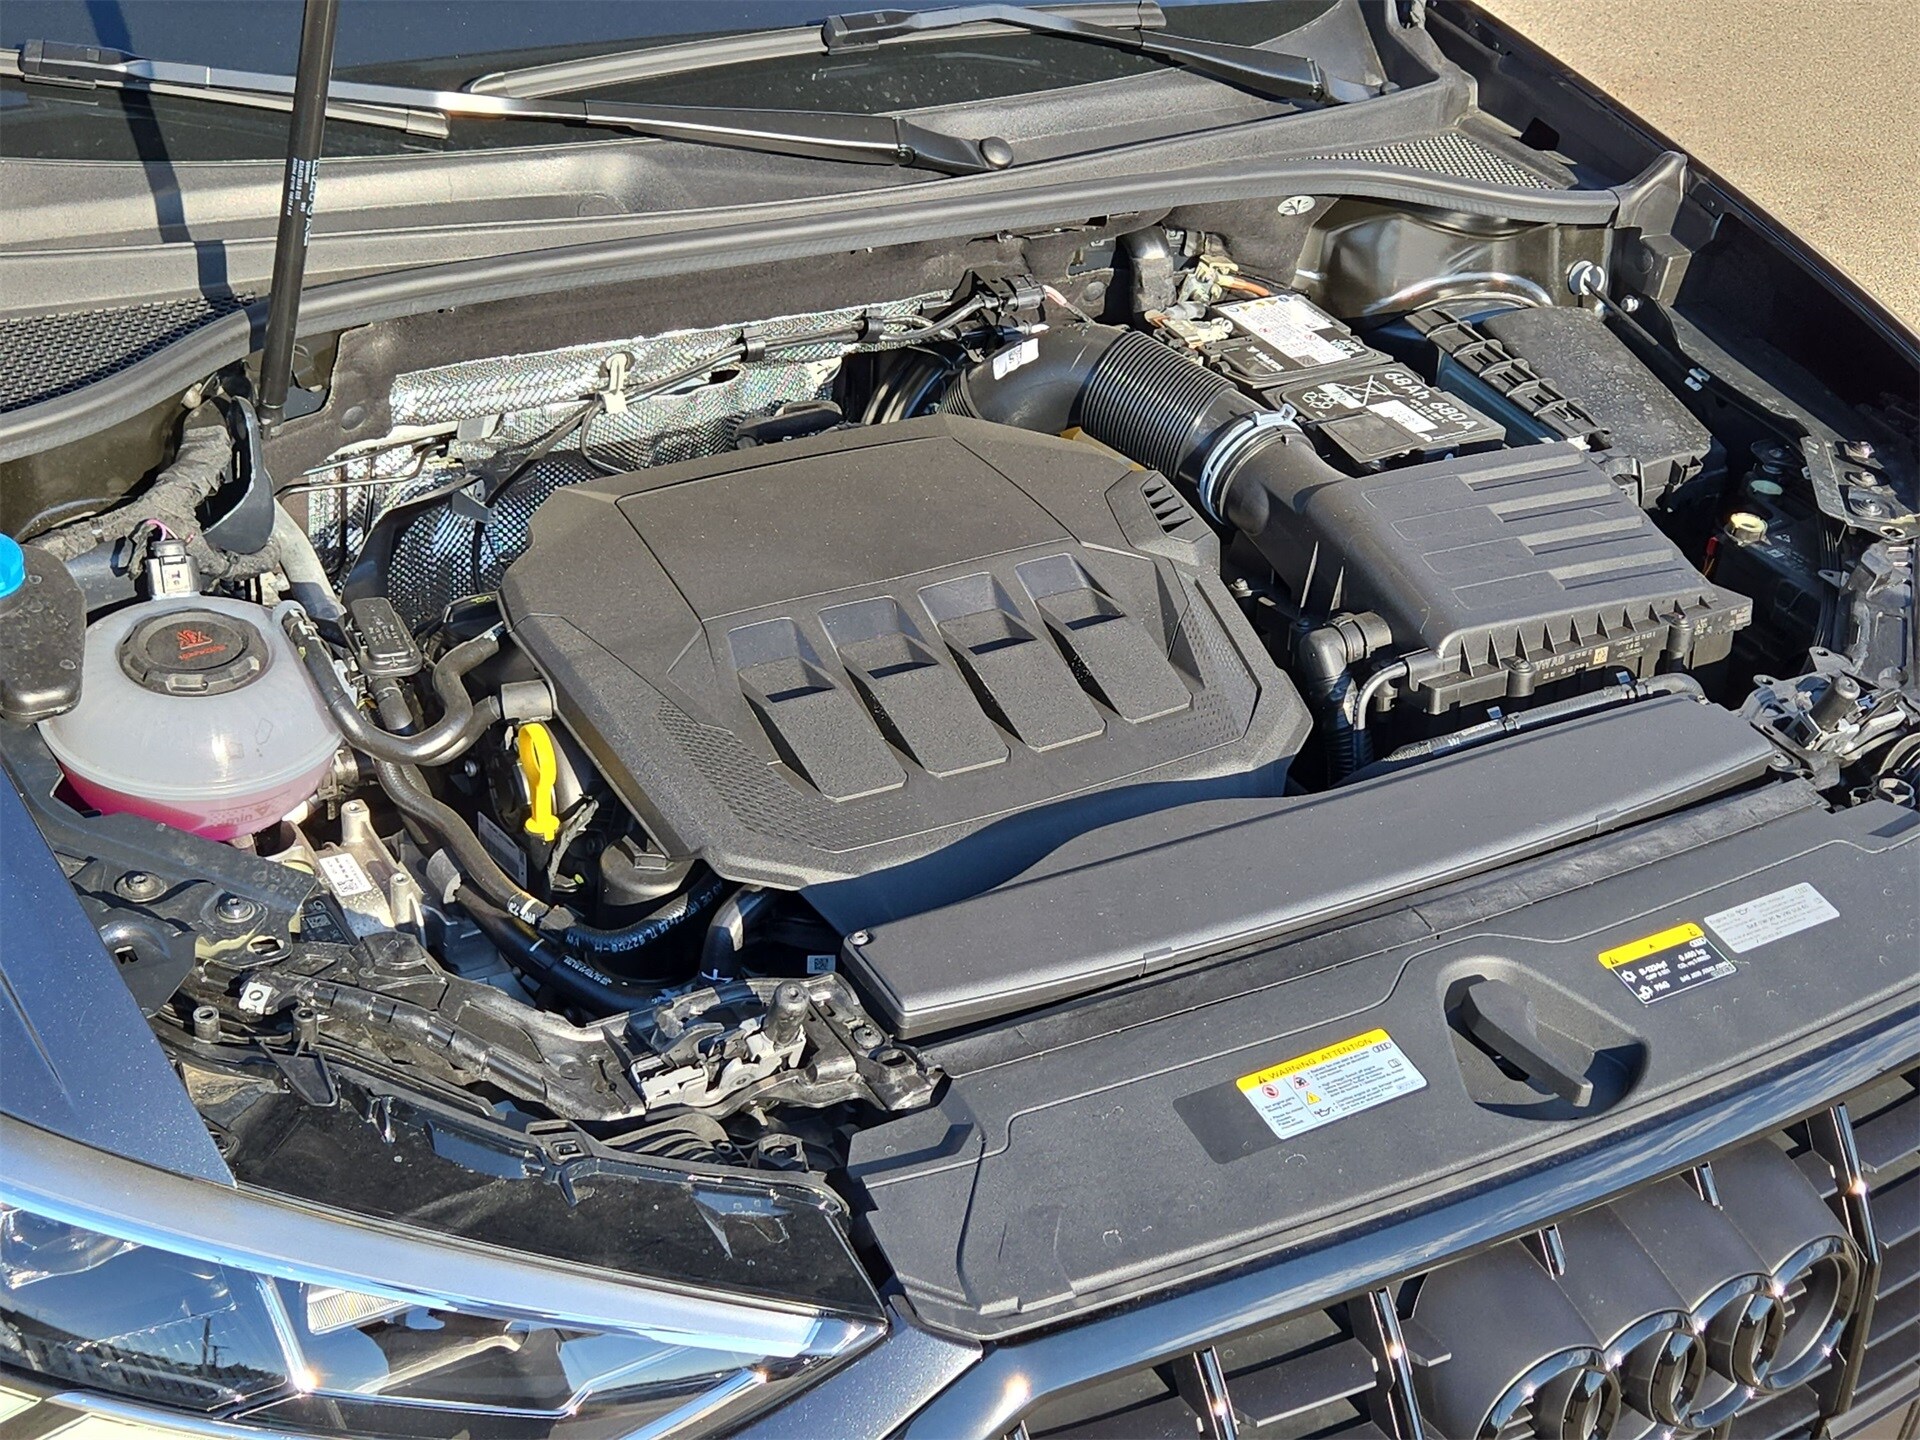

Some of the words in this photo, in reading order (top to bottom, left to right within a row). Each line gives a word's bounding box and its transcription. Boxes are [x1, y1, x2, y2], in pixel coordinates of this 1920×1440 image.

[1384, 372, 1430, 400] 68Ah
[226, 812, 253, 825] min
[1268, 1058, 1317, 1080] WARNING
[1321, 1038, 1373, 1061] ATTENTION
